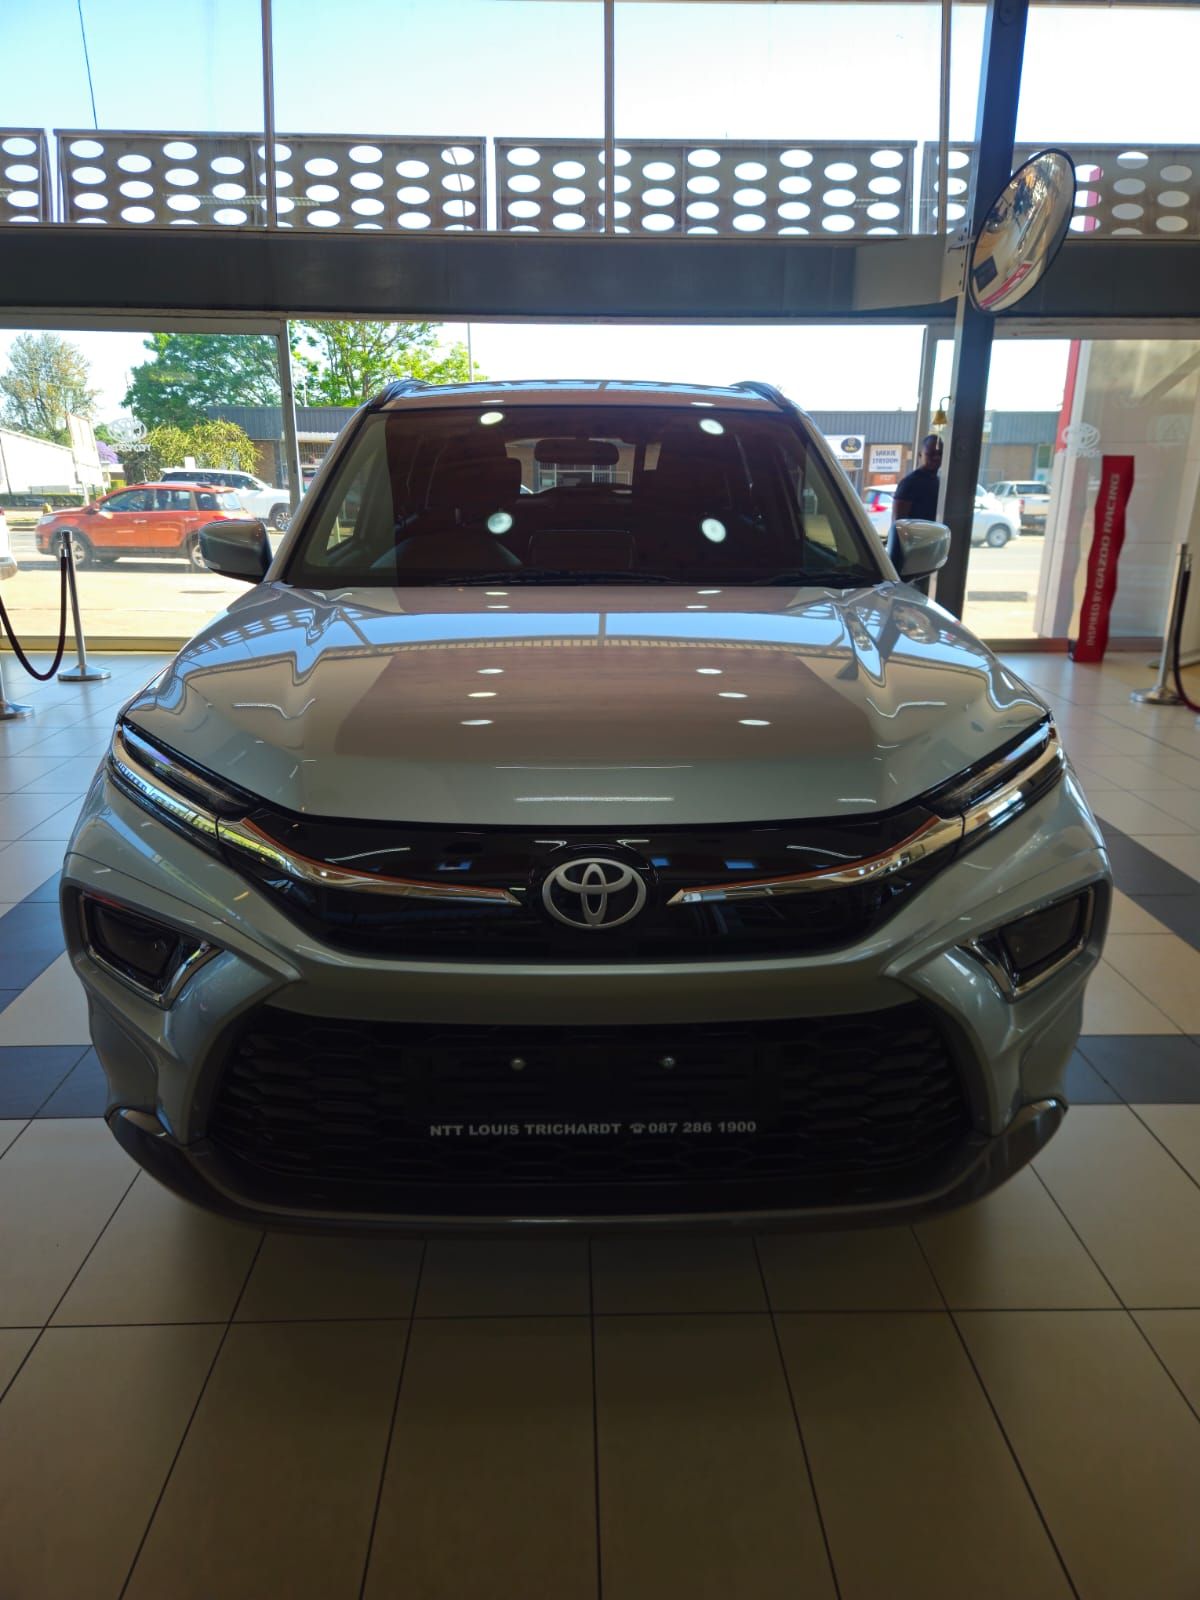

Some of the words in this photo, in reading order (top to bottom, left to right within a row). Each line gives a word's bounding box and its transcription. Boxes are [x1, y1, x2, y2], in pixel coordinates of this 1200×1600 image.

[1103, 473, 1120, 534] RACING
[1095, 535, 1111, 590] GAZOO
[1092, 589, 1103, 602] BY
[1086, 604, 1101, 646] INSPIRED
[430, 1125, 463, 1137] NTT
[468, 1124, 519, 1136] LOUIS
[524, 1123, 622, 1135] TRICHARDT
[648, 1122, 678, 1134] 087
[682, 1122, 712, 1133] 286
[717, 1121, 757, 1133] 1900
